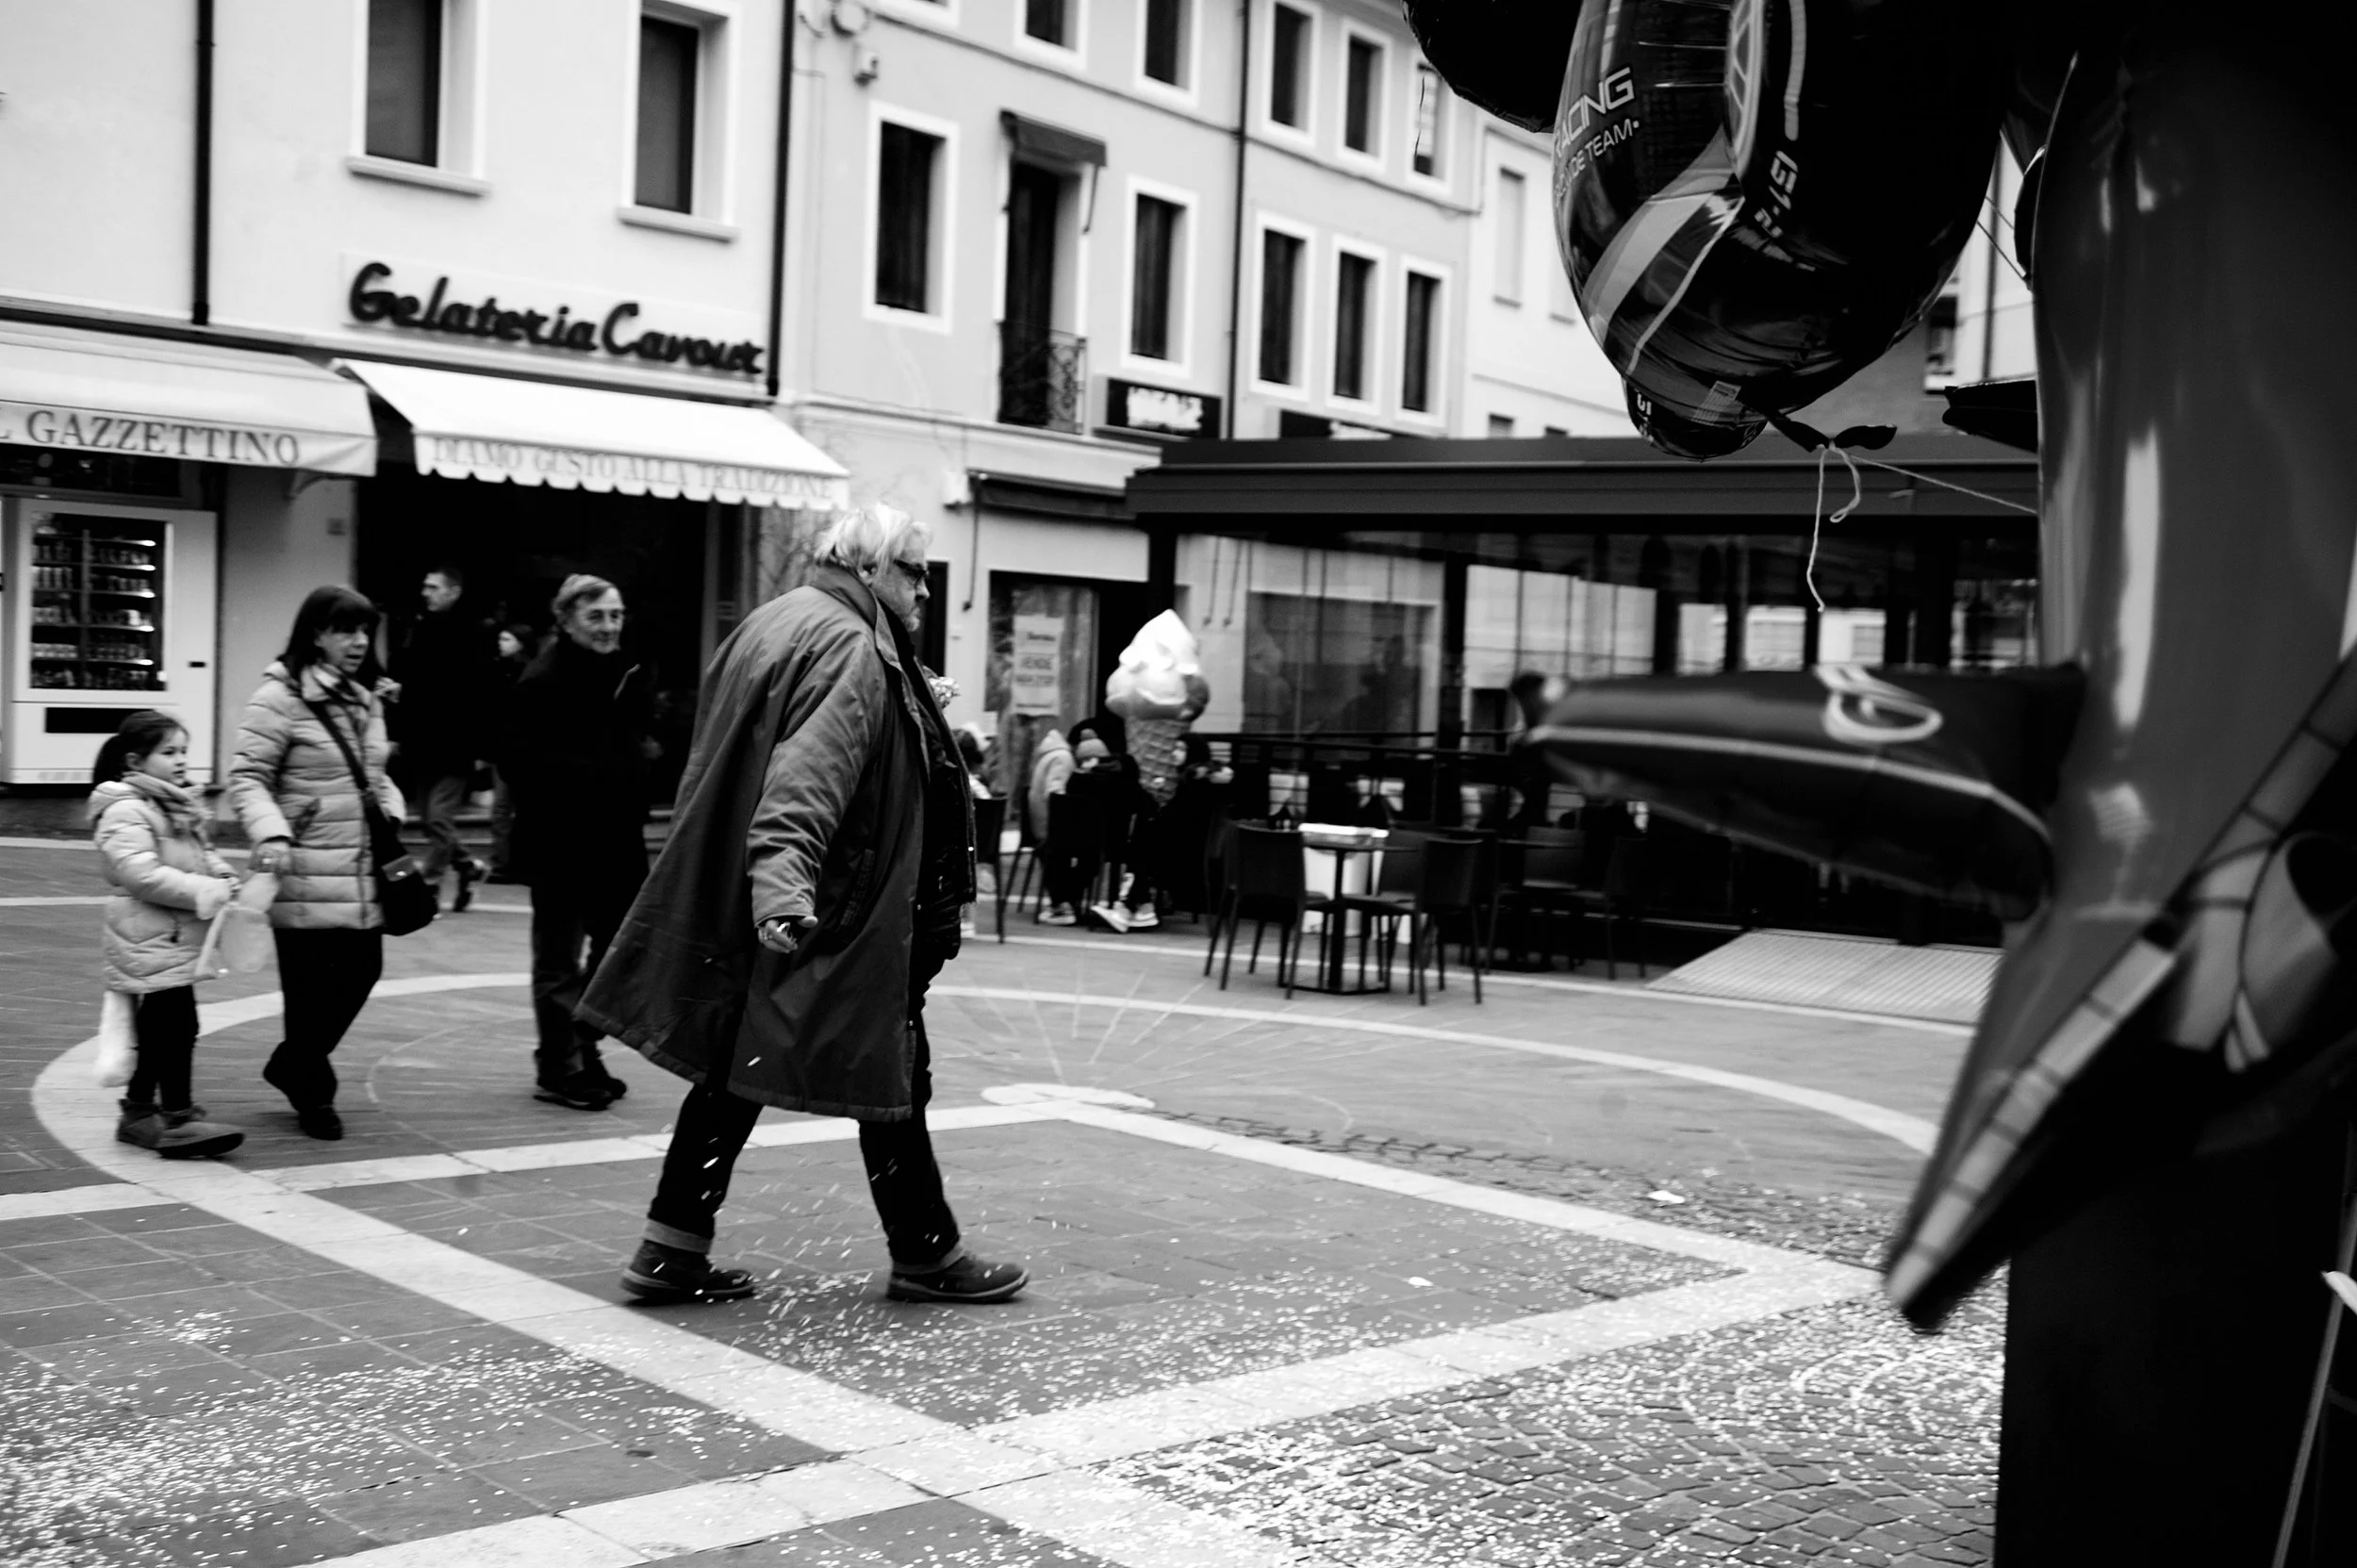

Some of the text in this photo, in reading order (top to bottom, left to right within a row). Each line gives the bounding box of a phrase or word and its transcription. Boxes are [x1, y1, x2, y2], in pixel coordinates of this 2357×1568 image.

[350, 262, 764, 374] Gelateria Cavour
[25, 409, 300, 465] GAZZETTINO
